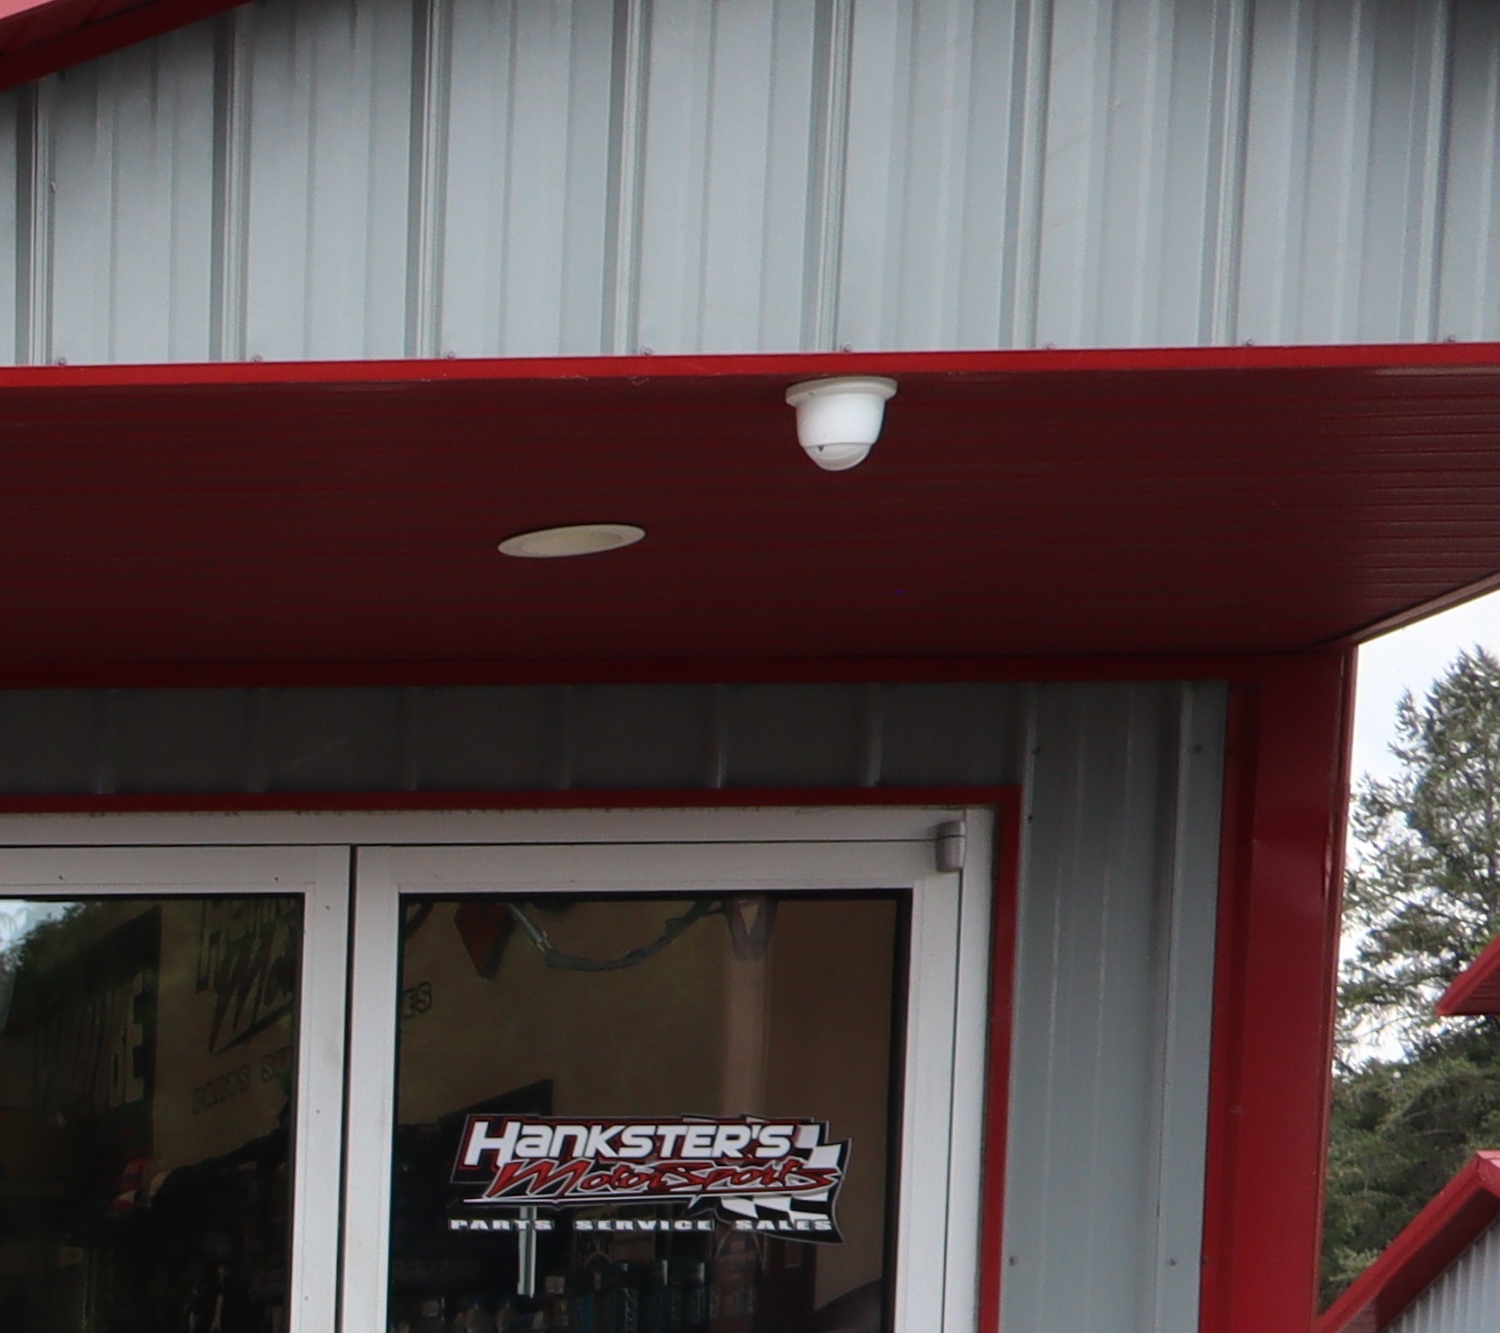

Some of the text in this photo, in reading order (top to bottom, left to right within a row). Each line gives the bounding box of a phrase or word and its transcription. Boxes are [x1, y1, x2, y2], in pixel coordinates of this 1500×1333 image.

[450, 1218, 833, 1231] PARTS SERVICE SALES
